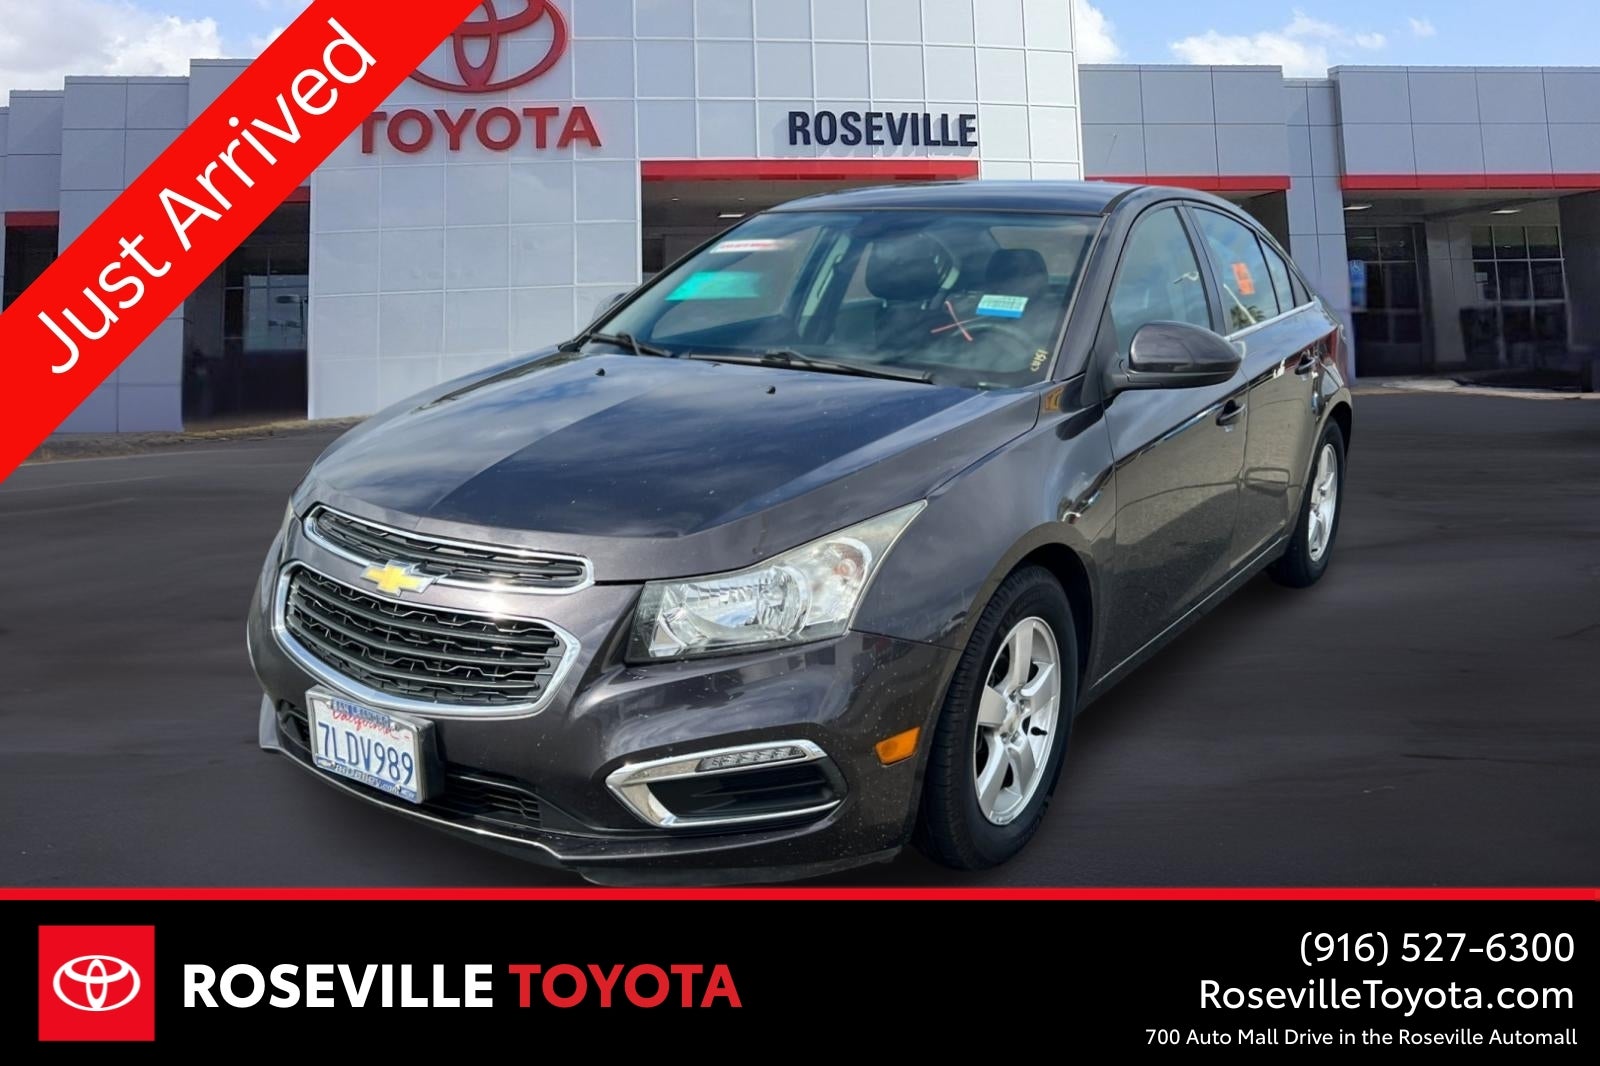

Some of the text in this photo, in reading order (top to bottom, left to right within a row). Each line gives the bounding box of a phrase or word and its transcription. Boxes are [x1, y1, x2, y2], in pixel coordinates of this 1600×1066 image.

[361, 106, 602, 154] TOYOTA
[788, 110, 978, 147] ROSEVILLE
[318, 721, 413, 785] 7LDV989
